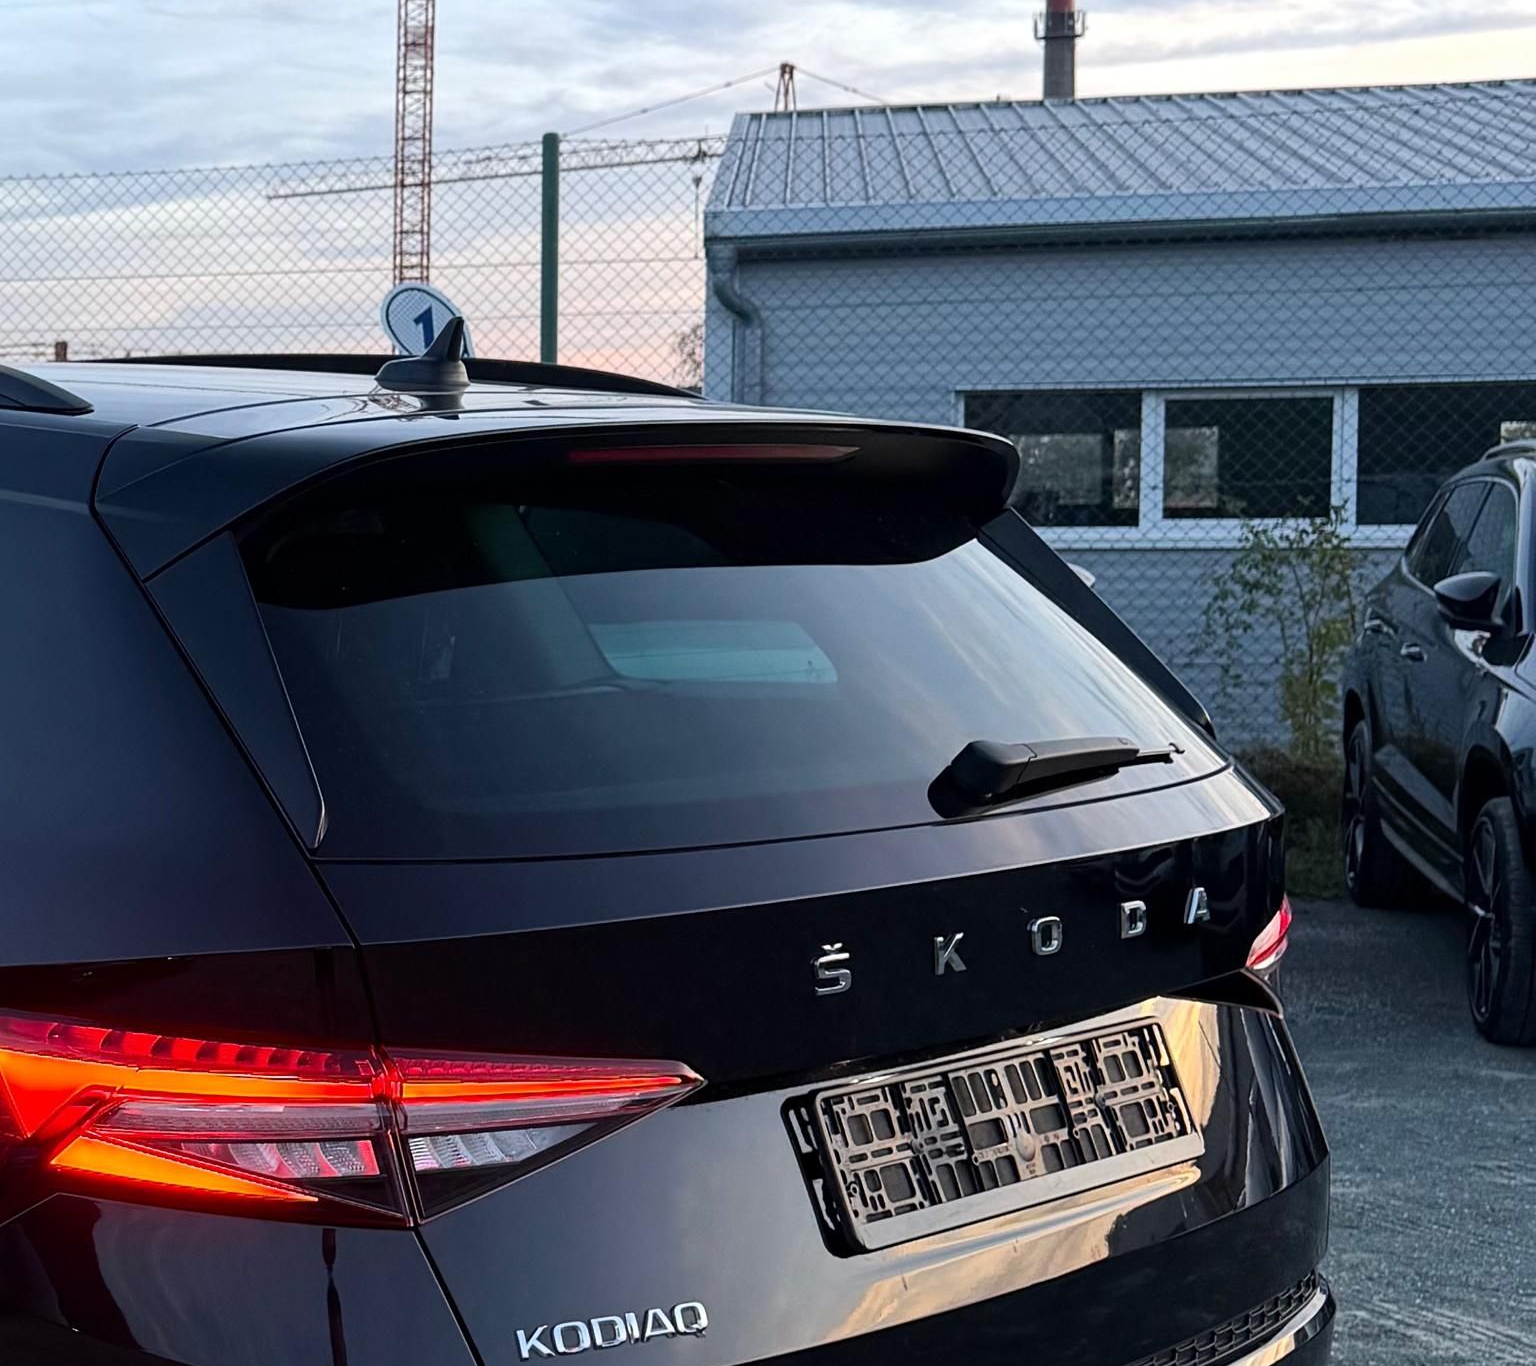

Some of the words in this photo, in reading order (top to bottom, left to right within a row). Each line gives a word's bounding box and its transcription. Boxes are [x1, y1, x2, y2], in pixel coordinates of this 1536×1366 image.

[413, 305, 434, 350] 1
[812, 886, 1211, 996] ŠKODA
[516, 1301, 709, 1361] KODIAQ
